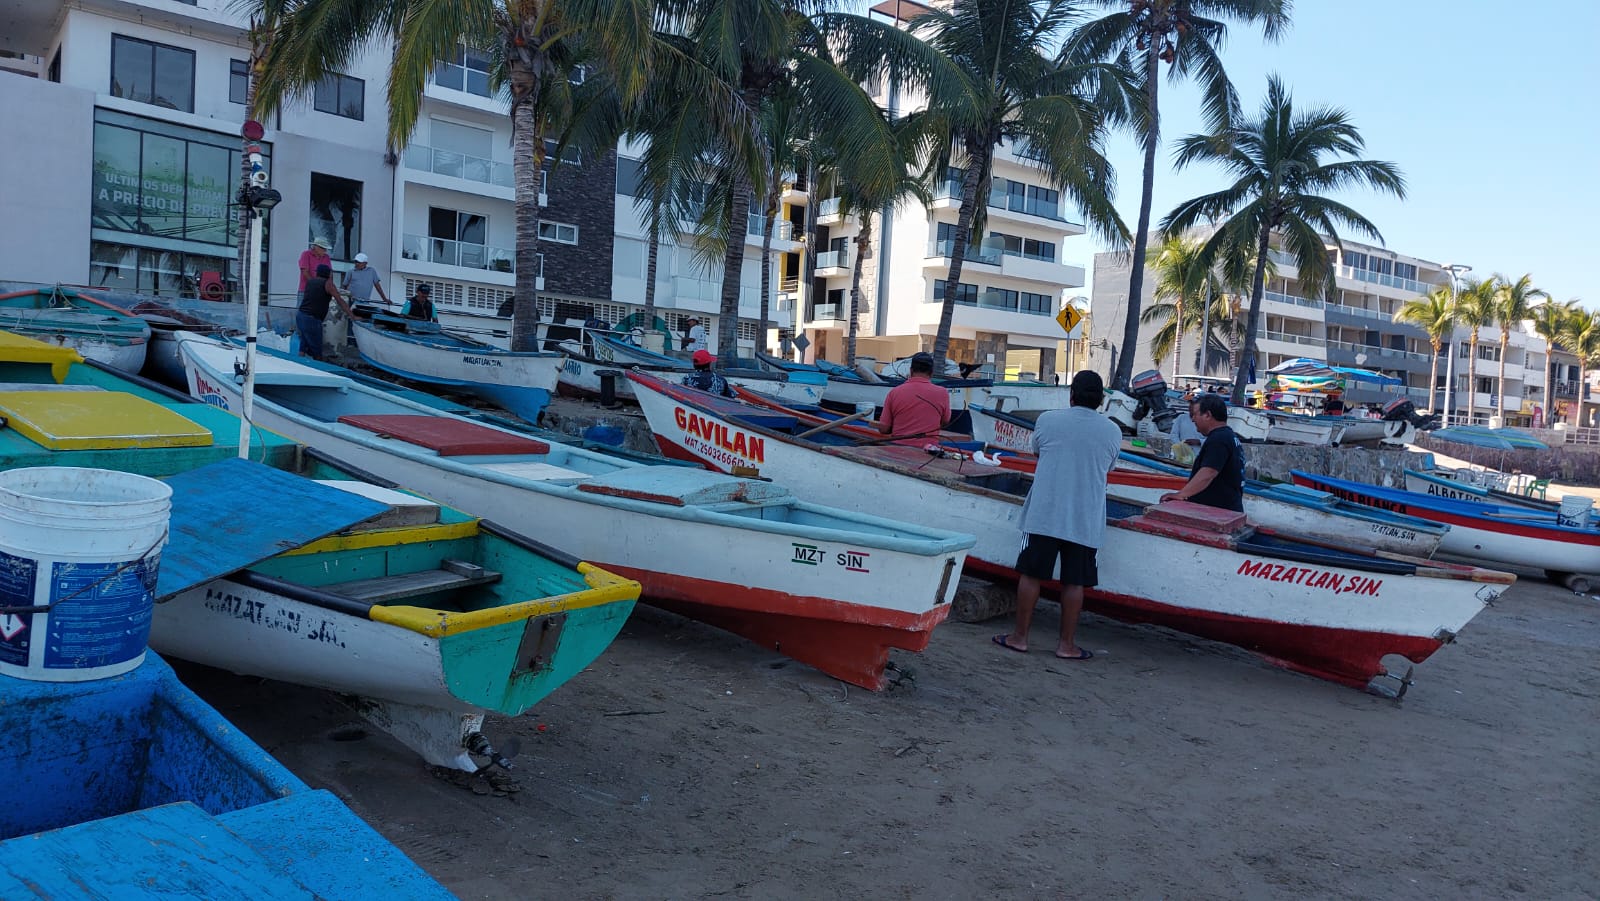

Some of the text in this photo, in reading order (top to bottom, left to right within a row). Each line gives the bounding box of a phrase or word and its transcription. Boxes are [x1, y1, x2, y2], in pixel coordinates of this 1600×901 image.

[98, 188, 110, 201] A
[113, 190, 166, 210] PRECIO
[674, 405, 765, 464] GAVILAN
[795, 547, 863, 569] MZT SIN
